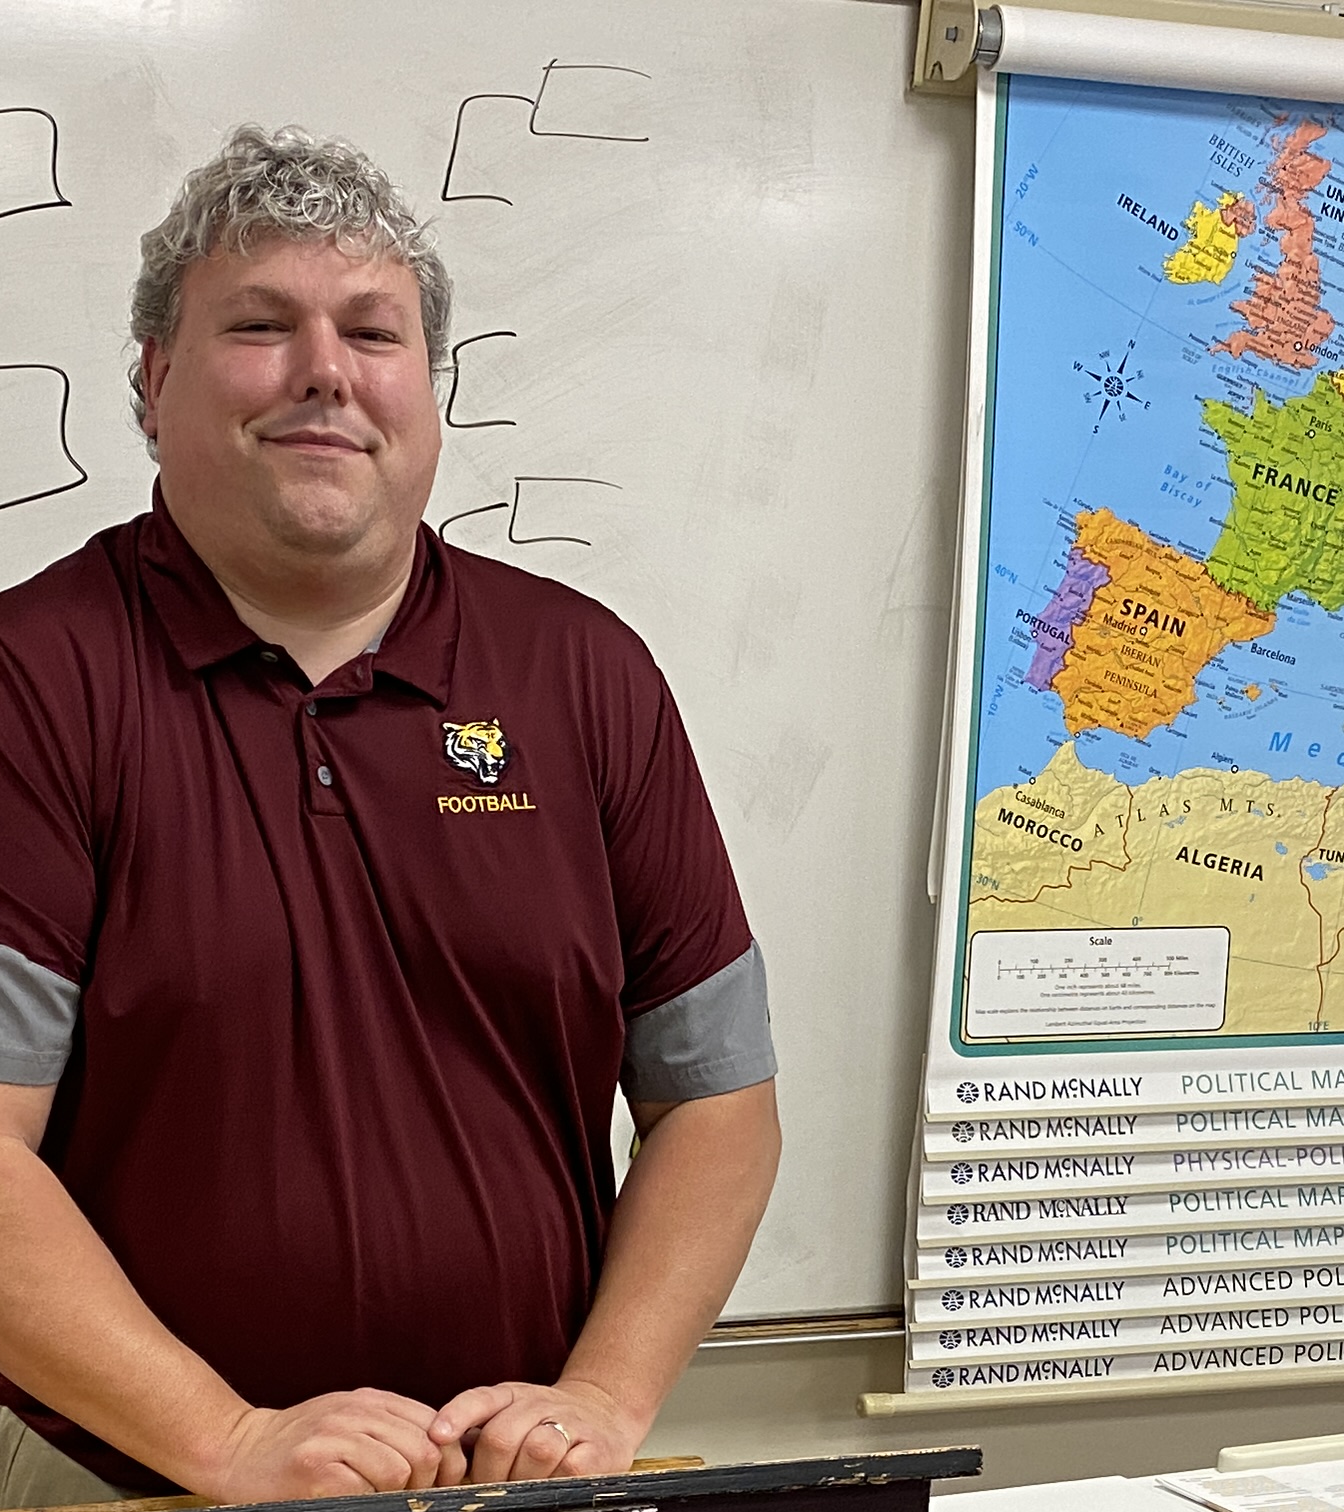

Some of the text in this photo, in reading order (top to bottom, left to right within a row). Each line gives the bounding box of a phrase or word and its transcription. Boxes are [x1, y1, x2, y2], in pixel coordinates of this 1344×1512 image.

[1208, 132, 1255, 169] BRITISH
[1209, 150, 1243, 177] ISLES
[1116, 192, 1179, 242] IRELAND
[1304, 339, 1339, 362] London
[1309, 416, 1333, 434] Paris
[1251, 463, 1338, 506] FRANCE
[1015, 608, 1072, 645] PORTUGAL
[1103, 614, 1136, 636] Madrid
[1119, 599, 1187, 637] SPAIN
[1121, 644, 1162, 668] IBERIAN
[1251, 642, 1296, 665] Barcelona
[1104, 670, 1158, 699] PENINSULA
[437, 793, 536, 814] FOOTBALL
[1015, 790, 1065, 821] Casablanca
[998, 808, 1083, 853] MOROCCO
[1092, 798, 1192, 839] ATLAS
[1175, 847, 1264, 881] ALGERIA
[1089, 937, 1112, 946] Scale
[985, 1082, 1045, 1102] RAND
[1182, 1072, 1302, 1095] POLITICAL
[979, 1121, 1041, 1141] RAND
[1176, 1108, 1296, 1133] POLITICAL
[979, 1162, 1039, 1182] RAND
[973, 1202, 1031, 1223] RAND
[1170, 1189, 1288, 1212] POLITICAL
[1166, 1232, 1284, 1255] POLITICAL
[1294, 1227, 1344, 1247] MAP
[973, 1246, 1033, 1266] RAND
[1163, 1271, 1292, 1298] ADVANCED
[970, 1289, 1029, 1309] RAND
[1160, 1309, 1289, 1335] ADVANCED
[966, 1327, 1026, 1347] RAND
[1154, 1346, 1283, 1373] ADVANCED
[959, 1365, 1020, 1387] RAND
